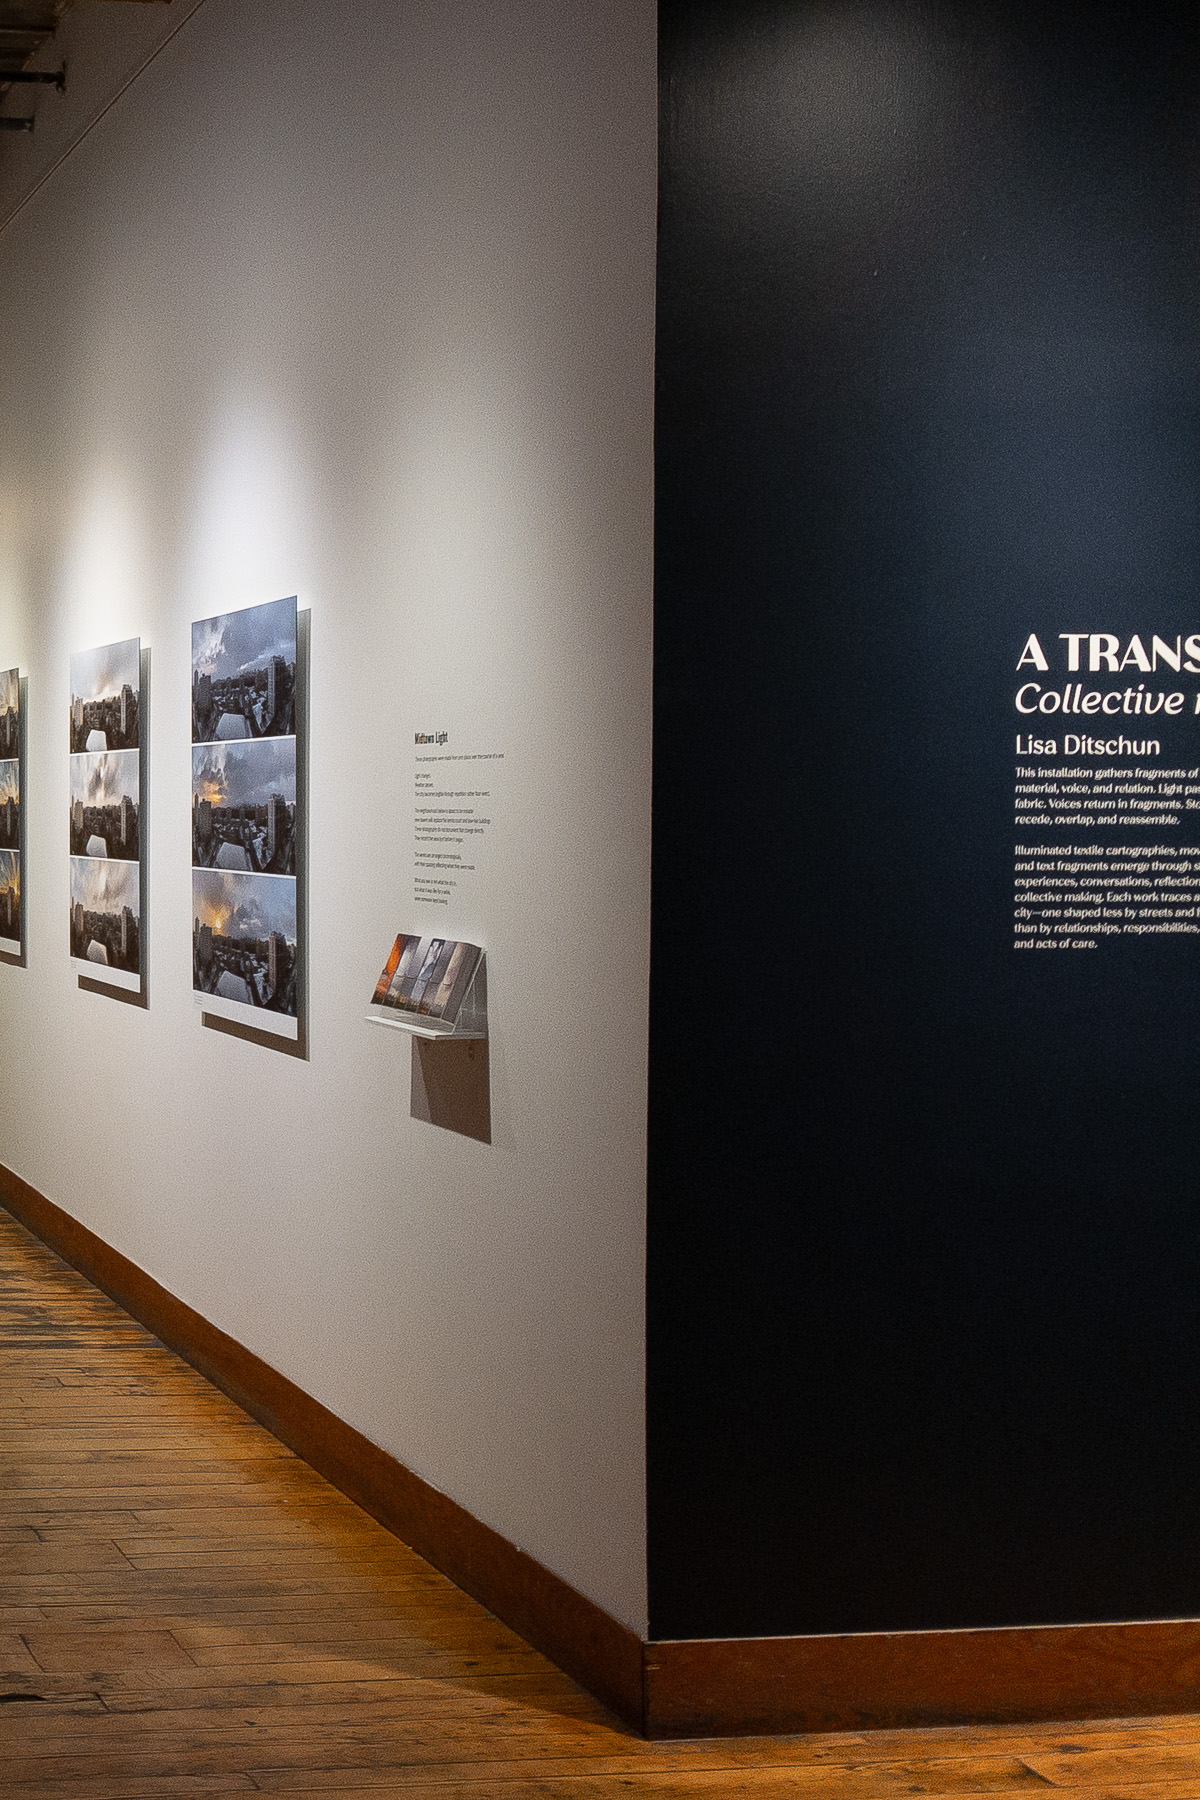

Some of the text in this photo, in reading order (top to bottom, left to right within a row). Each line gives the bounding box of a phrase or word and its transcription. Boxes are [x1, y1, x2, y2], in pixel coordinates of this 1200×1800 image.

[1016, 634, 1200, 673] A TRANS
[1015, 683, 1184, 714] Collective
[435, 731, 448, 746] Light
[1016, 734, 1160, 755] Lisa Ditschun
[1016, 767, 1199, 780] This installation gathers fragments of
[1015, 783, 1059, 794] material,
[1061, 783, 1091, 794] voice,
[1093, 783, 1112, 793] and
[1115, 783, 1156, 793] relation.
[1158, 783, 1182, 796] Light
[1015, 798, 1047, 808] fabric.
[1049, 799, 1082, 809] Voices
[1084, 800, 1115, 809] return
[1118, 798, 1128, 809] in
[1130, 798, 1184, 811] fragments.
[1015, 814, 1180, 826] recede, overlap, and reassemble.
[1015, 845, 1071, 855] Illuminated
[1074, 845, 1104, 855] textile
[1106, 845, 1177, 858] cartographies,
[1015, 861, 1034, 871] and
[1037, 862, 1055, 871] text
[1057, 861, 1108, 873] fragments
[1110, 862, 1149, 873] emerge
[1152, 861, 1191, 873] through
[1015, 876, 1078, 888] experiences,
[1080, 876, 1152, 887] conversations,
[1015, 892, 1062, 902] collective
[1065, 892, 1104, 904] making.
[1107, 892, 1131, 902] Each
[1134, 892, 1159, 902] work
[1161, 893, 1192, 902] traces
[1064, 907, 1101, 919] shaped
[1103, 908, 1122, 917] less
[1125, 907, 1137, 919] by
[1139, 908, 1173, 917] streets
[1175, 907, 1194, 917] and
[1014, 922, 1200, 935] than by relationships, responsibilities,
[1014, 939, 1033, 948] and
[1036, 940, 1057, 948] acts
[1059, 938, 1071, 948] of
